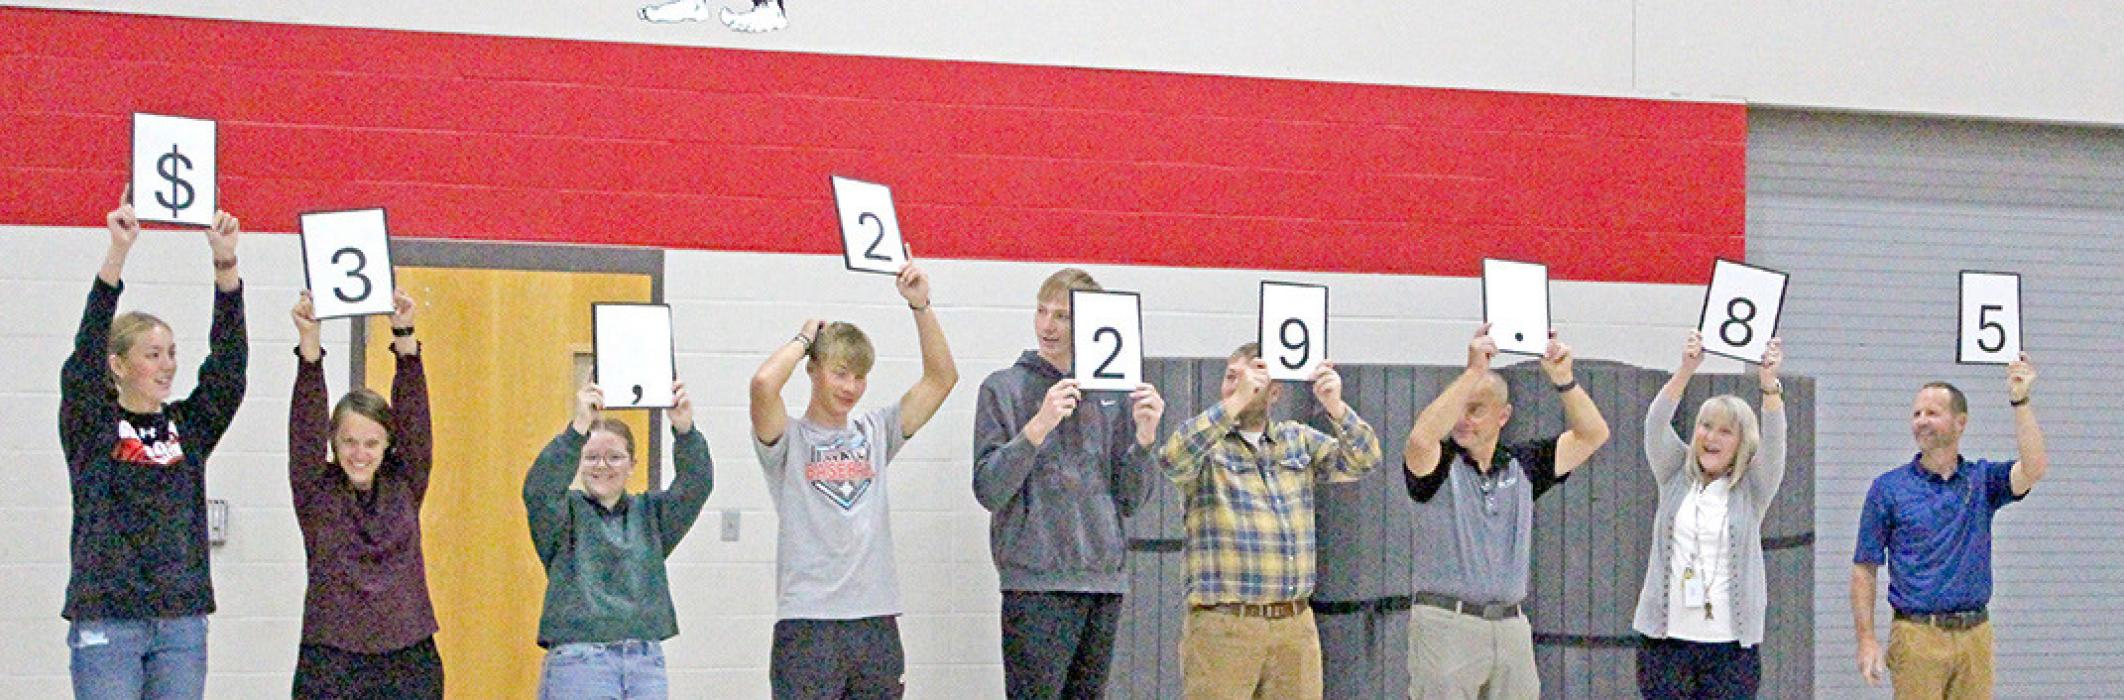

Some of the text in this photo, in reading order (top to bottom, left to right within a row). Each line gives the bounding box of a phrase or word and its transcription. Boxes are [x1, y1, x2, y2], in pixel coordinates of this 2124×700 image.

[154, 144, 195, 218] $
[858, 211, 892, 262] 2
[331, 247, 372, 304] 3
[1279, 318, 1310, 370] 9
[1719, 297, 1757, 348] 8
[1976, 304, 2006, 354] 5
[1092, 326, 1125, 380] 2
[631, 384, 643, 405] ,
